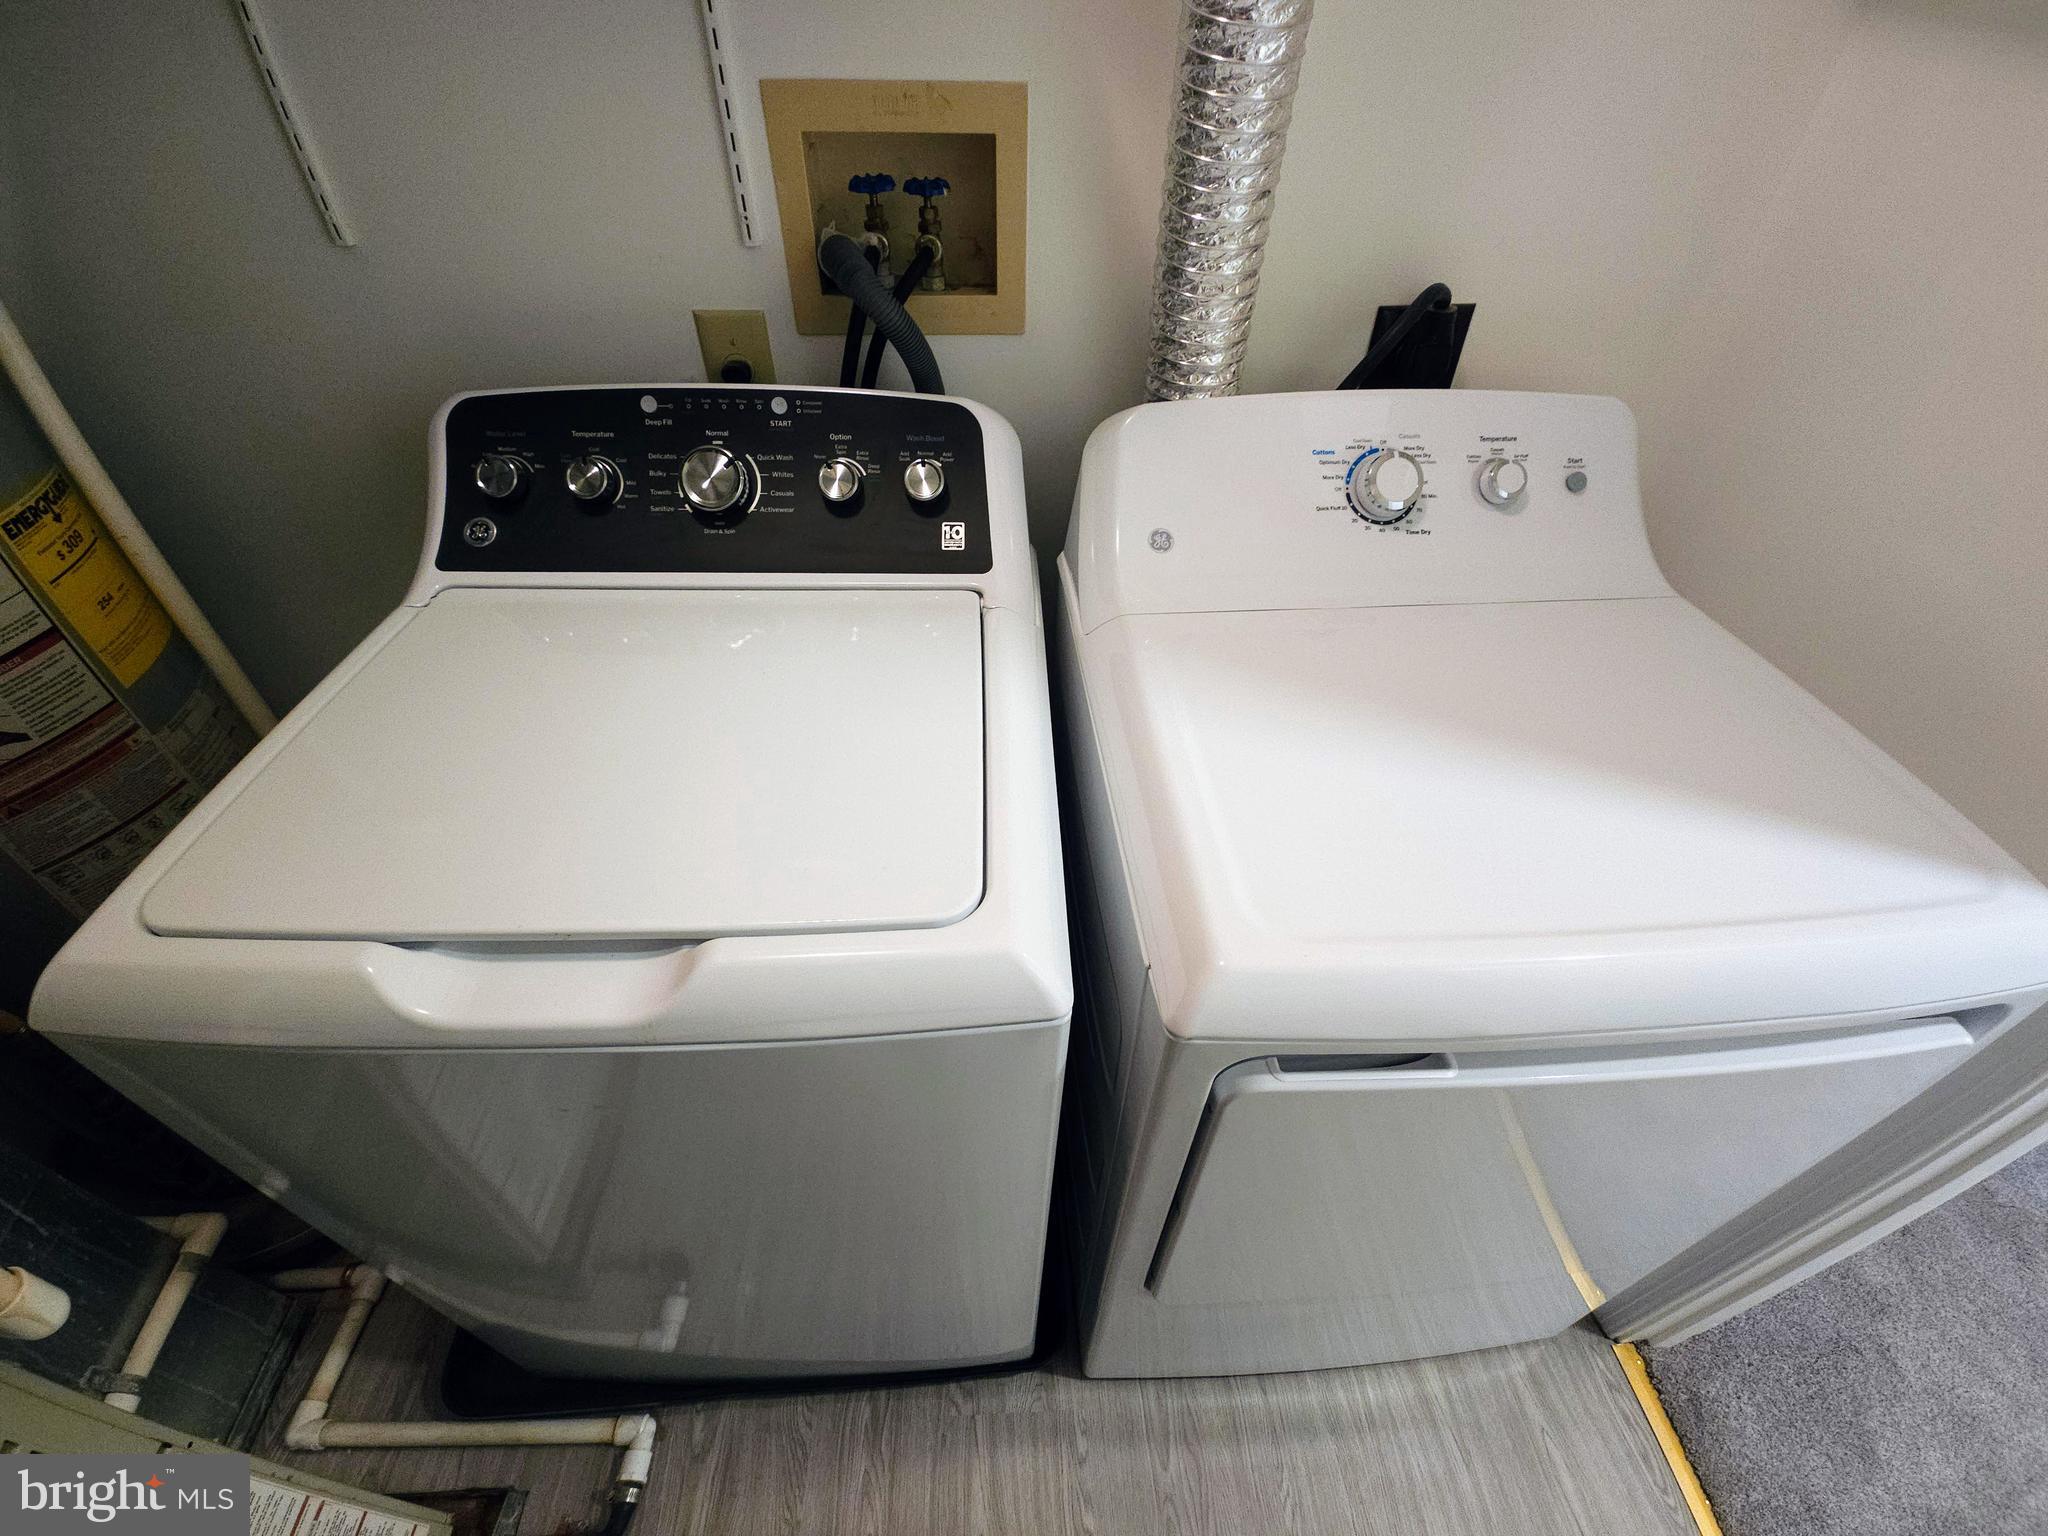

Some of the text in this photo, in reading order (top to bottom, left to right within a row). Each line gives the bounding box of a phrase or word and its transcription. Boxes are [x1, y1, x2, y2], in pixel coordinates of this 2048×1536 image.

[645, 418, 662, 427] Deep
[571, 430, 615, 438] Temperature
[829, 433, 852, 441] Option
[1479, 435, 1518, 443] Temperature
[649, 470, 667, 478] Bulky
[62, 529, 83, 553] 309
